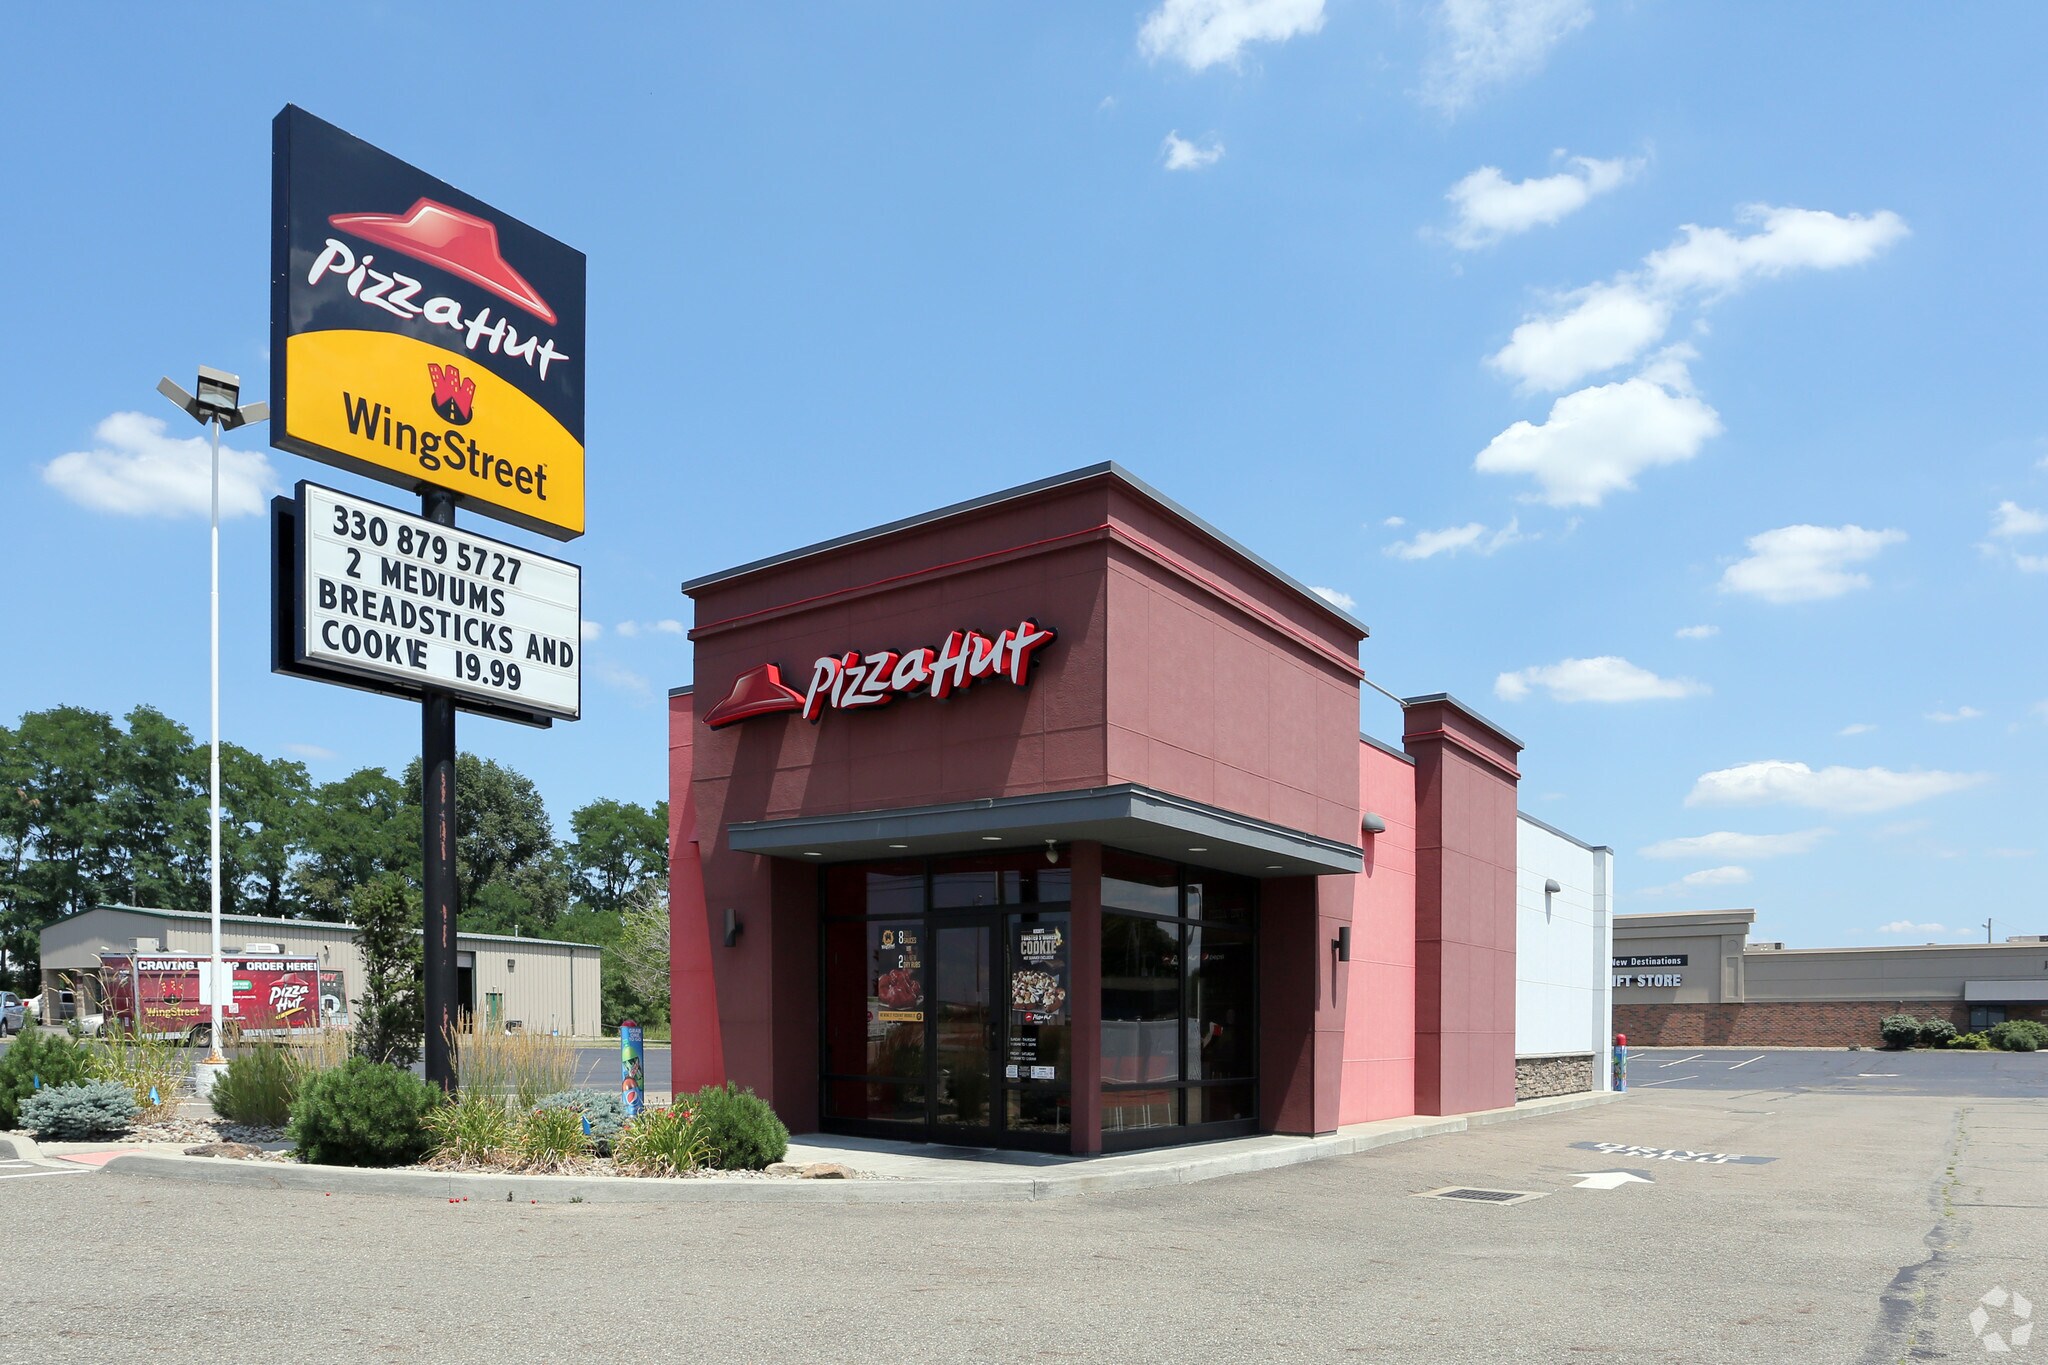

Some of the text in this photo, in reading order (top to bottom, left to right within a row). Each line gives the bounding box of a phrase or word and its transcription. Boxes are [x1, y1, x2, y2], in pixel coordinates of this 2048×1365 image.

[308, 238, 570, 381] Pizza Hut
[343, 391, 547, 500] WingStreet
[333, 505, 521, 585] 330 879 5727
[346, 547, 505, 617] 2 MEDIUMS
[319, 578, 574, 668] BREADSTICKS AND
[456, 651, 521, 690] 19.99
[802, 621, 1053, 719] Pizza Hut
[898, 930, 904, 944] 8
[1020, 941, 1057, 955] COOKIE
[138, 961, 195, 970] CRAVING
[246, 962, 285, 971] ORDER
[286, 962, 317, 971] HERE!
[898, 954, 904, 968] 2
[1631, 956, 1682, 966] Destinations
[1637, 974, 1683, 988] STORE
[269, 984, 309, 1005] Pizza
[146, 1006, 199, 1018] WingStreet
[276, 995, 306, 1012] Hut
